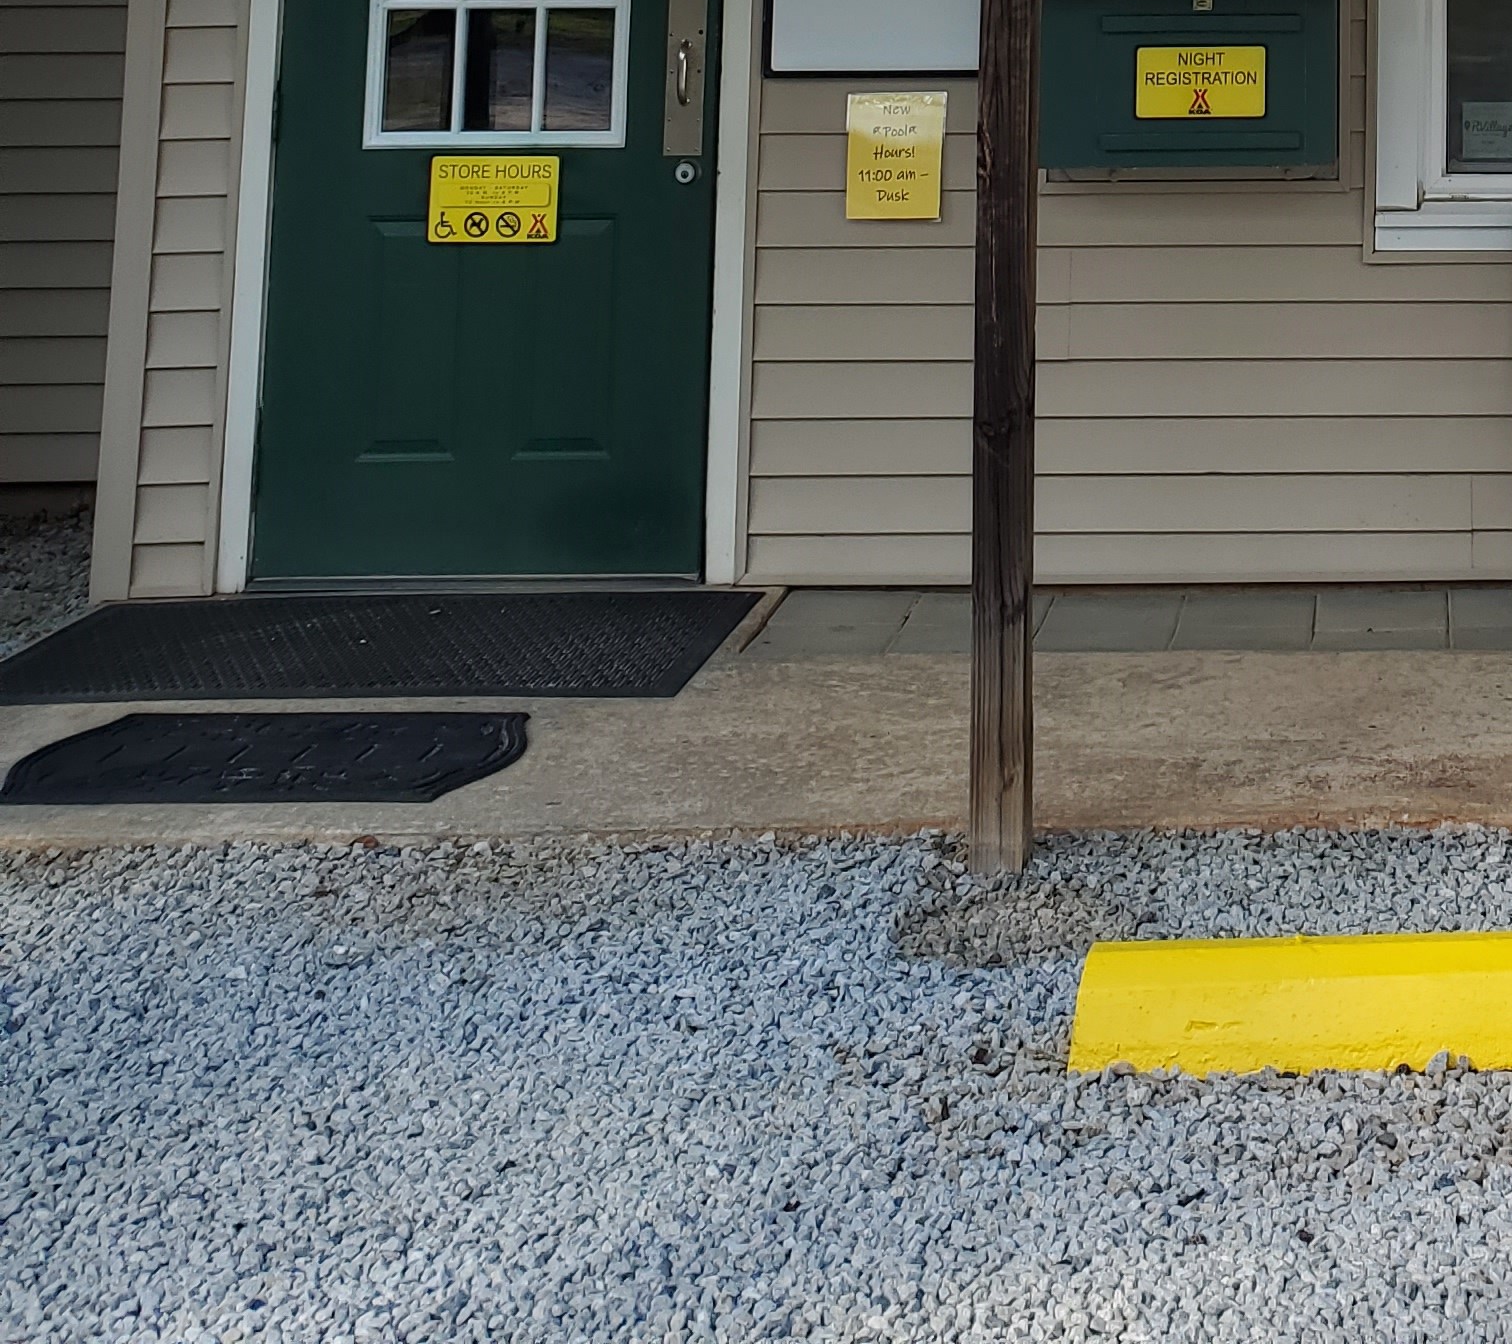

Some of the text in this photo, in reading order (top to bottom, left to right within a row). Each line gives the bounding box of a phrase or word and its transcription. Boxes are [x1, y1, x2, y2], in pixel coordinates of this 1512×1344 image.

[1178, 52, 1225, 66] NIGHT
[1145, 71, 1257, 85] REGISTRATION
[883, 105, 911, 115] New
[873, 144, 915, 160] Hours!
[438, 164, 552, 179] STORE HOURS
[858, 170, 893, 182] 11:00
[896, 169, 916, 180] am
[876, 188, 910, 202] Dusk
